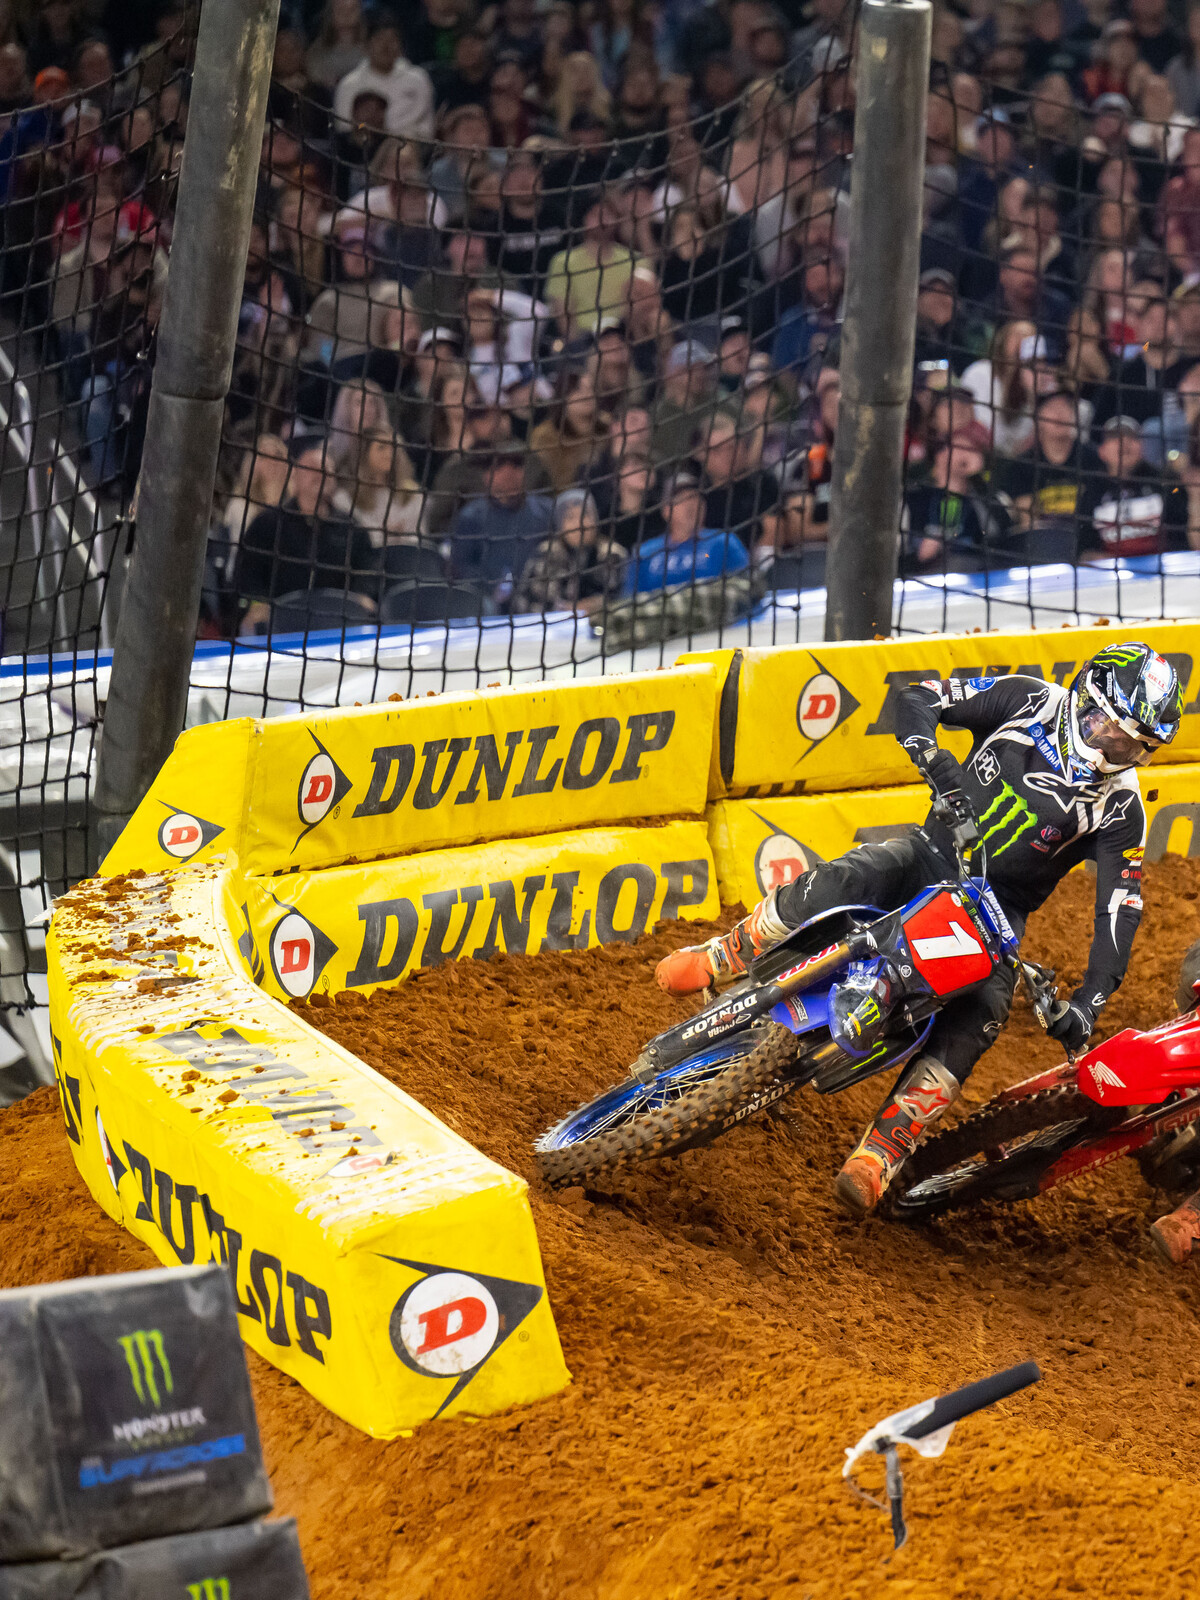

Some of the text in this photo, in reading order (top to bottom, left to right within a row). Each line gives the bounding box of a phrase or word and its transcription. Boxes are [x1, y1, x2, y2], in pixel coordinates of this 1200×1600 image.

[802, 692, 839, 721] D
[302, 709, 677, 820] D DUNLOP
[166, 825, 199, 847] D
[280, 937, 311, 975] D
[344, 858, 710, 989] DUNLOP
[910, 920, 984, 961] 1
[681, 993, 758, 1041] DUNLOP
[1087, 1064, 1105, 1099] HONDA
[721, 1081, 796, 1130] DUNLOP
[1055, 1145, 1131, 1186] DUNLOP
[416, 1295, 488, 1356] D
